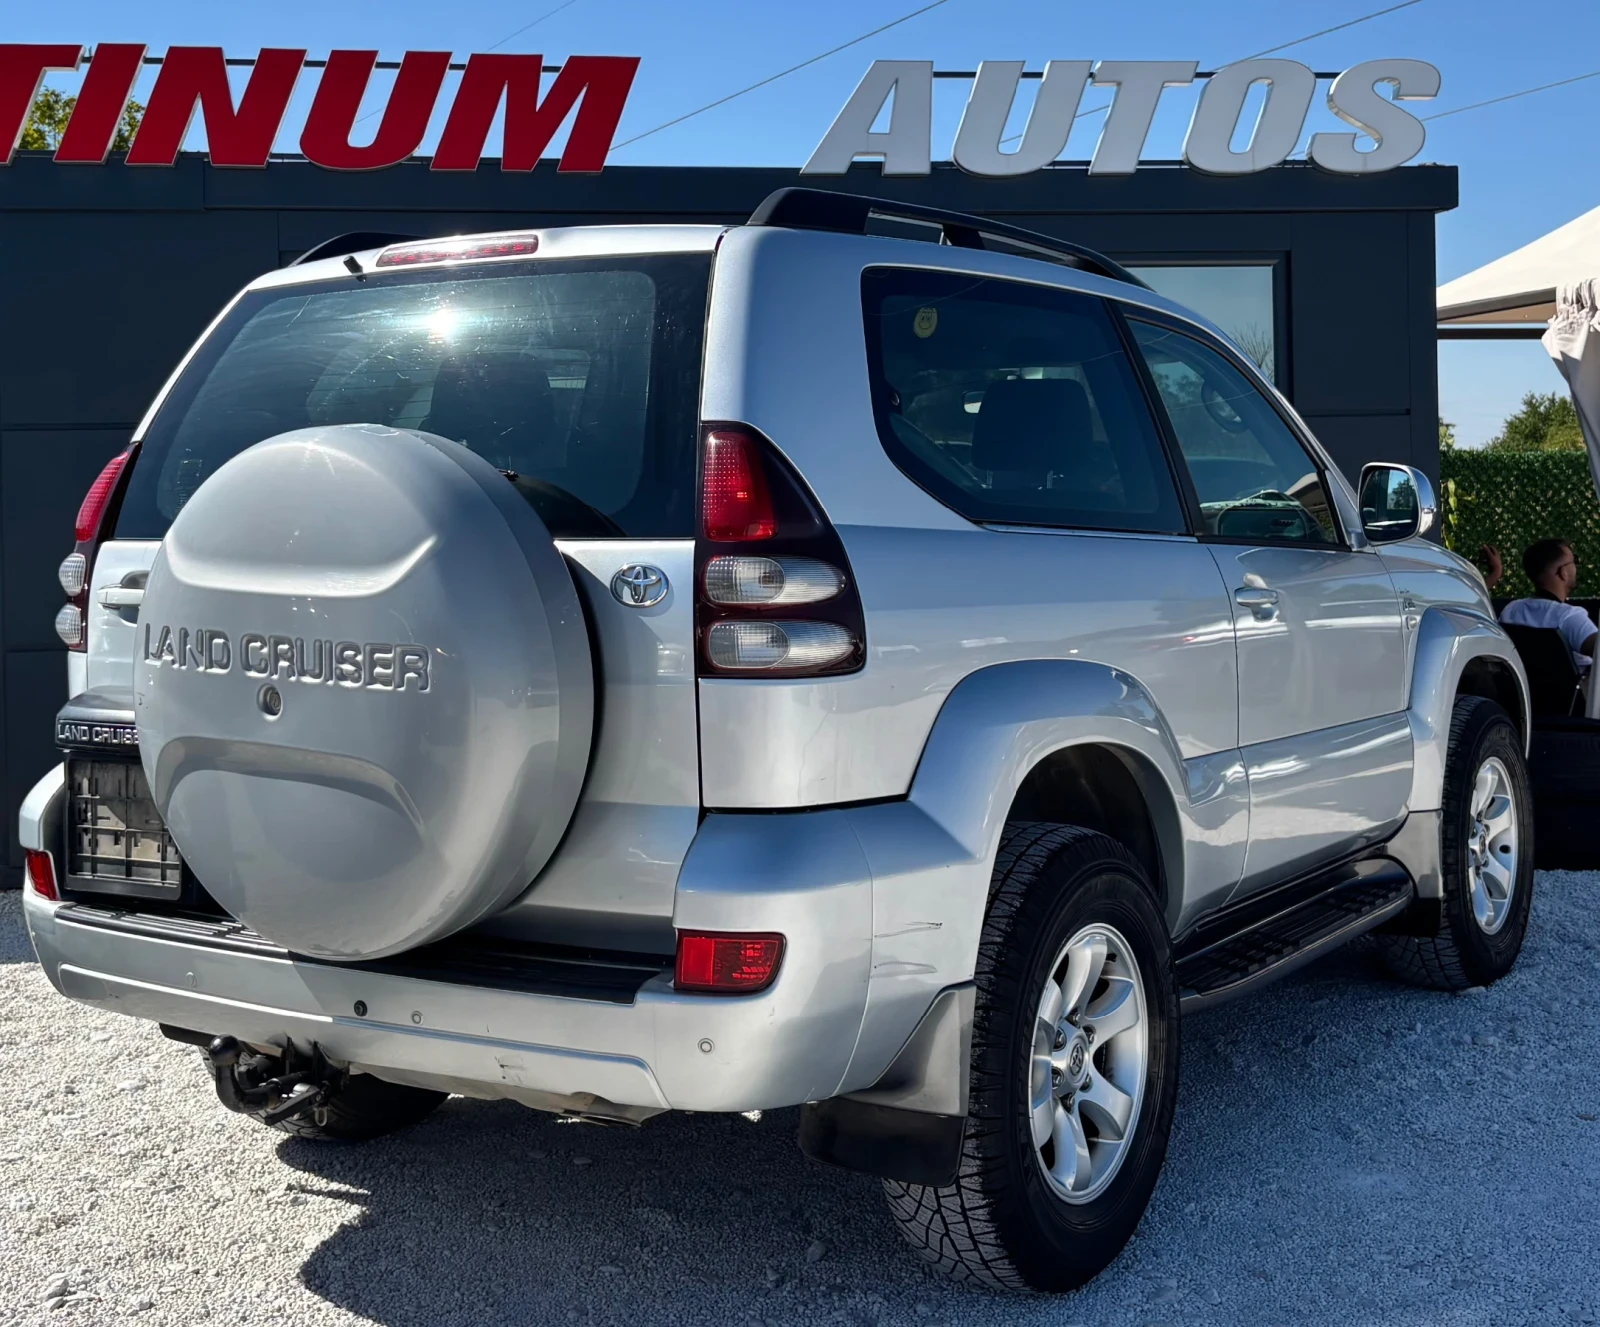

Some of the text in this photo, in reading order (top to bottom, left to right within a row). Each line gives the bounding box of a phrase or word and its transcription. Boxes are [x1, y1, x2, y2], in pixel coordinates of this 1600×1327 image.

[0, 43, 1442, 177] TINUM AUTOS
[144, 622, 431, 693] LAND CRUISER
[57, 724, 89, 741] LAND
